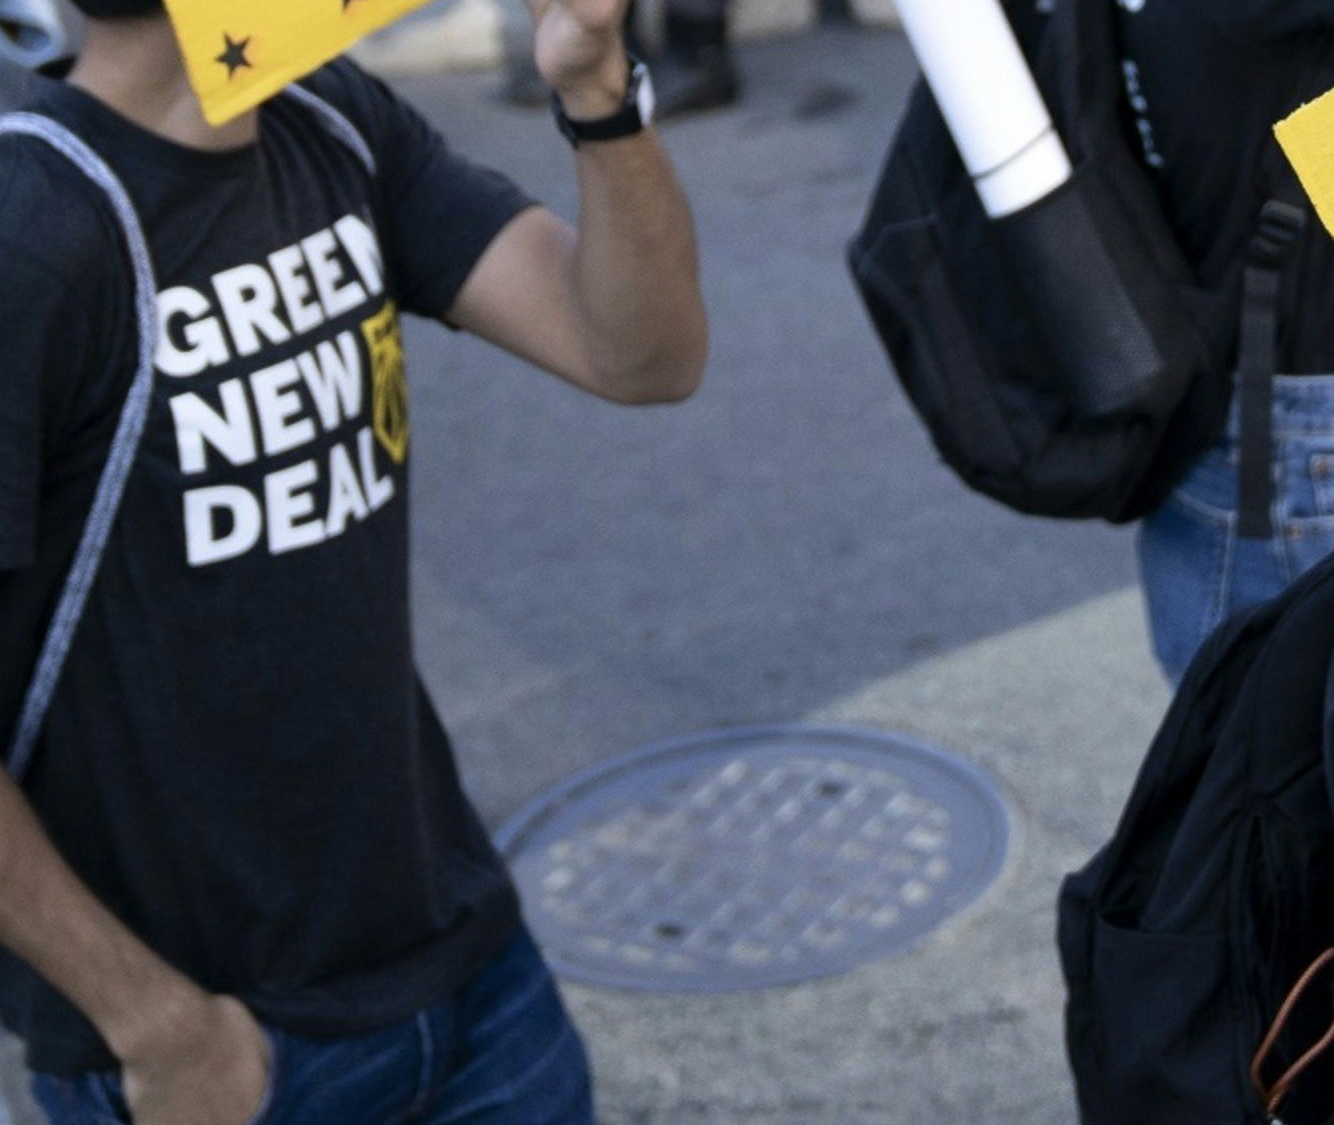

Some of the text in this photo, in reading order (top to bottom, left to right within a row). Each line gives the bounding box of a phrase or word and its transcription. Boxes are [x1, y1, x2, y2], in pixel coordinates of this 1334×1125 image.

[154, 213, 384, 377] GREEN
[169, 330, 362, 474] NEW
[183, 426, 395, 567] DEAL
